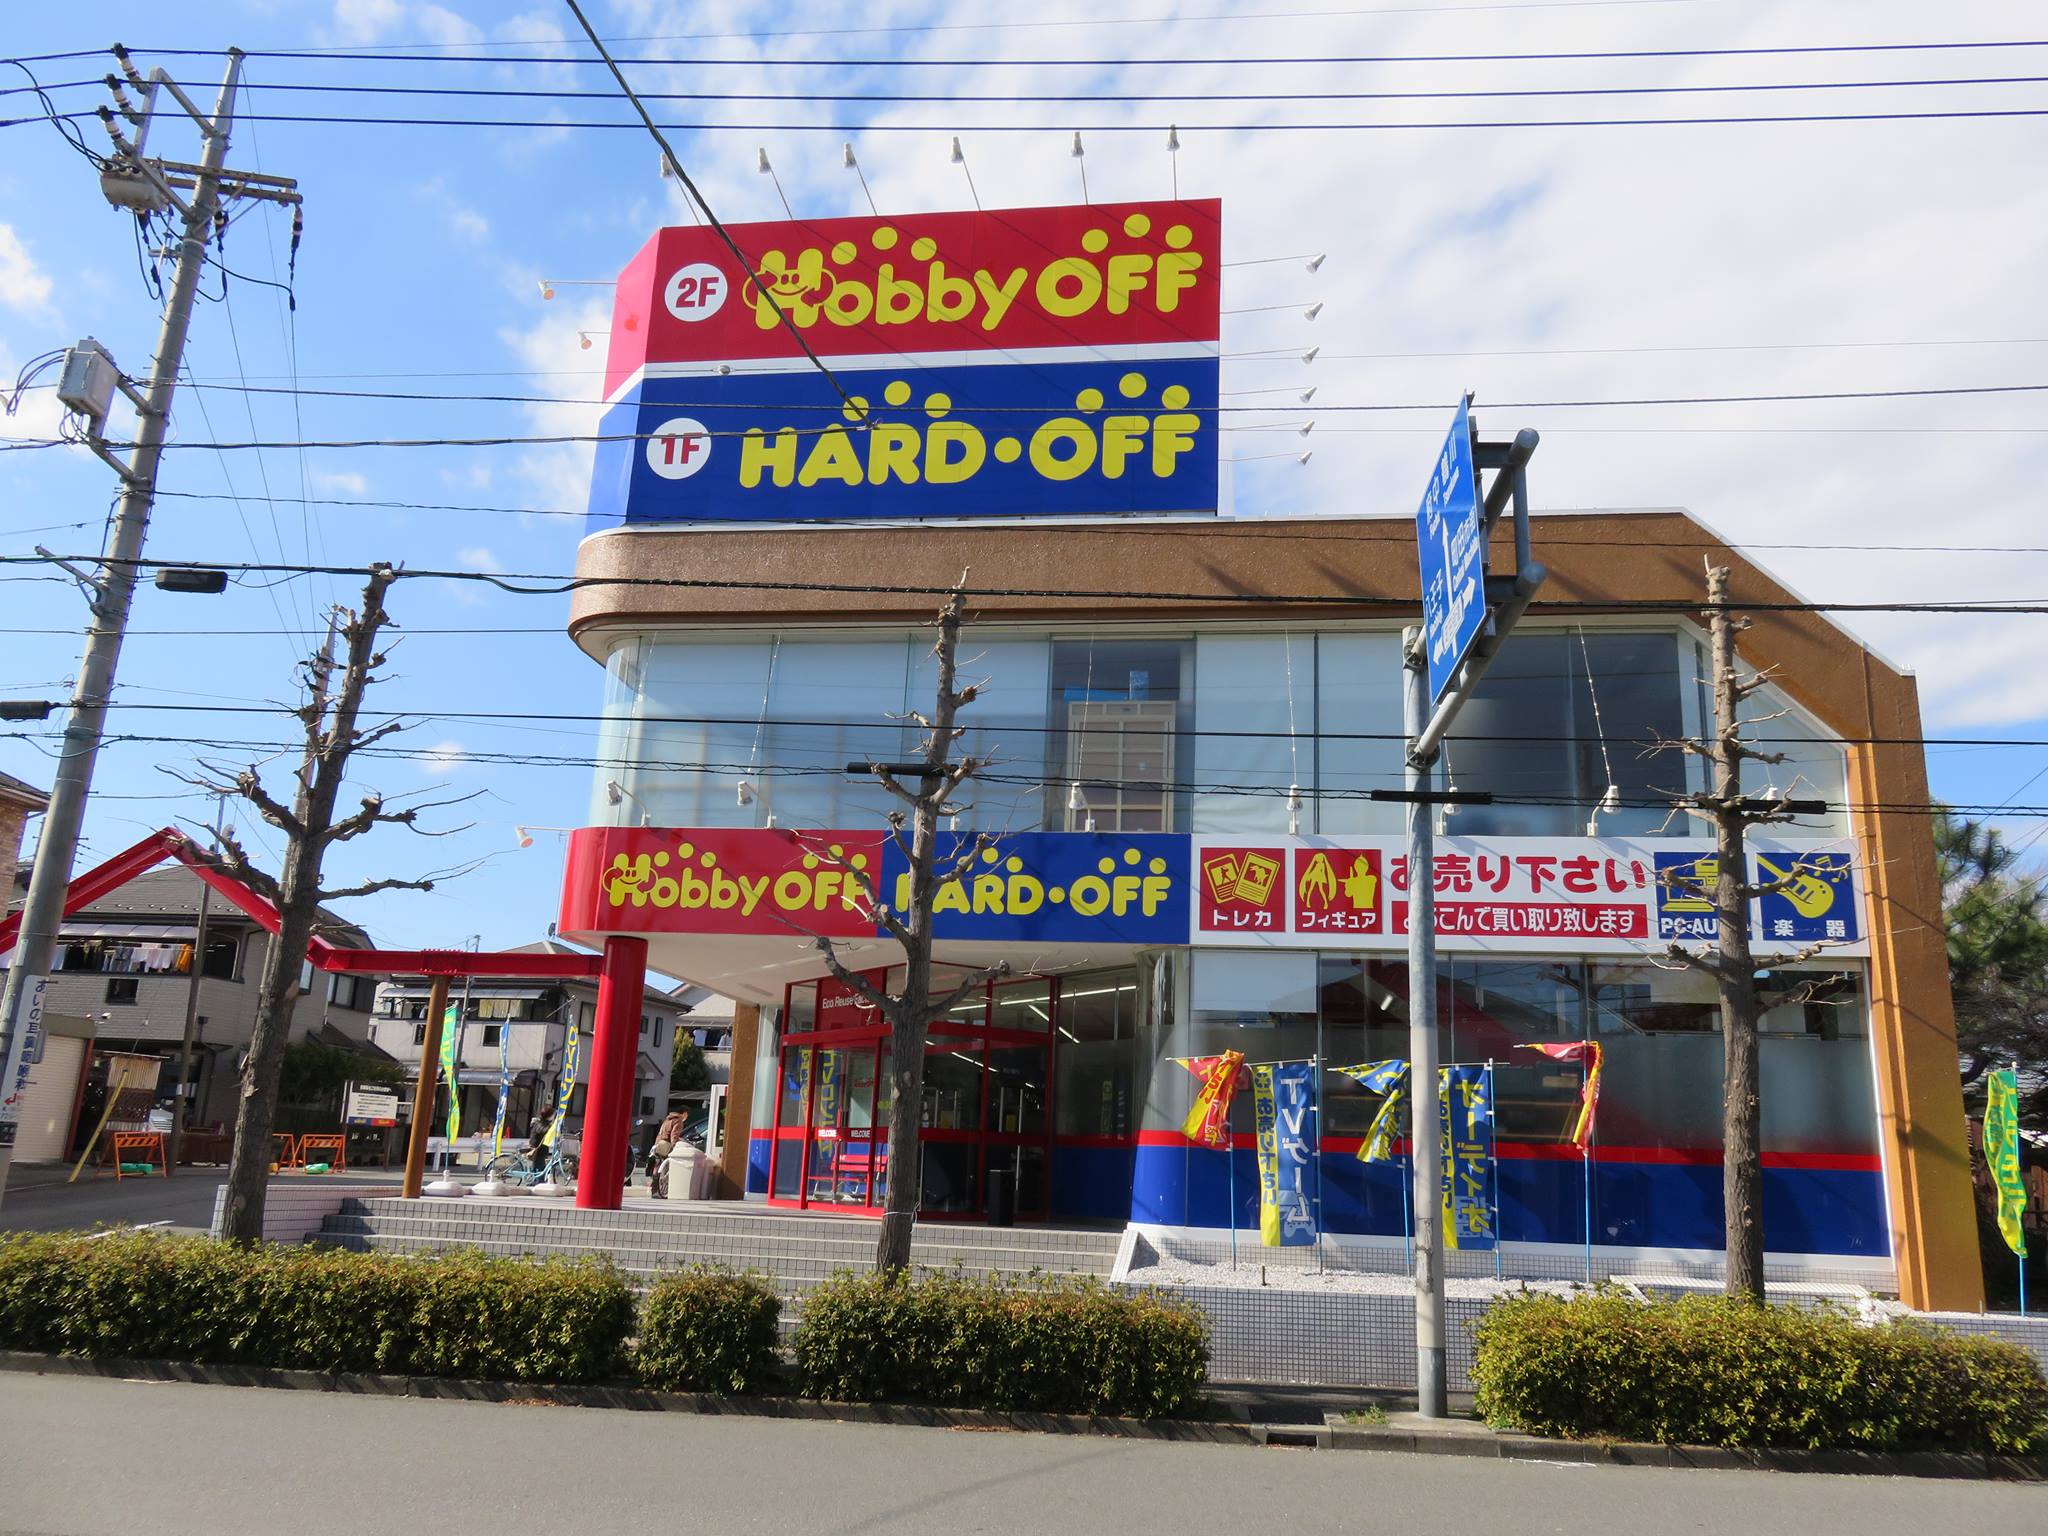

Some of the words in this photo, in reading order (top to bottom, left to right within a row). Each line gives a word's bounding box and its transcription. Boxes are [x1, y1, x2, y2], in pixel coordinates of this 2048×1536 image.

[677, 277, 719, 308] 2F
[746, 248, 1027, 330] Hobby
[1036, 252, 1203, 317] OFF
[661, 432, 700, 465] 1F
[609, 853, 770, 918] Hobby
[773, 871, 870, 911] OFF
[1213, 909, 1272, 927] トレカ
[1301, 911, 1377, 929] フィギュア
[1403, 906, 1636, 935] こんで買い取り致します
